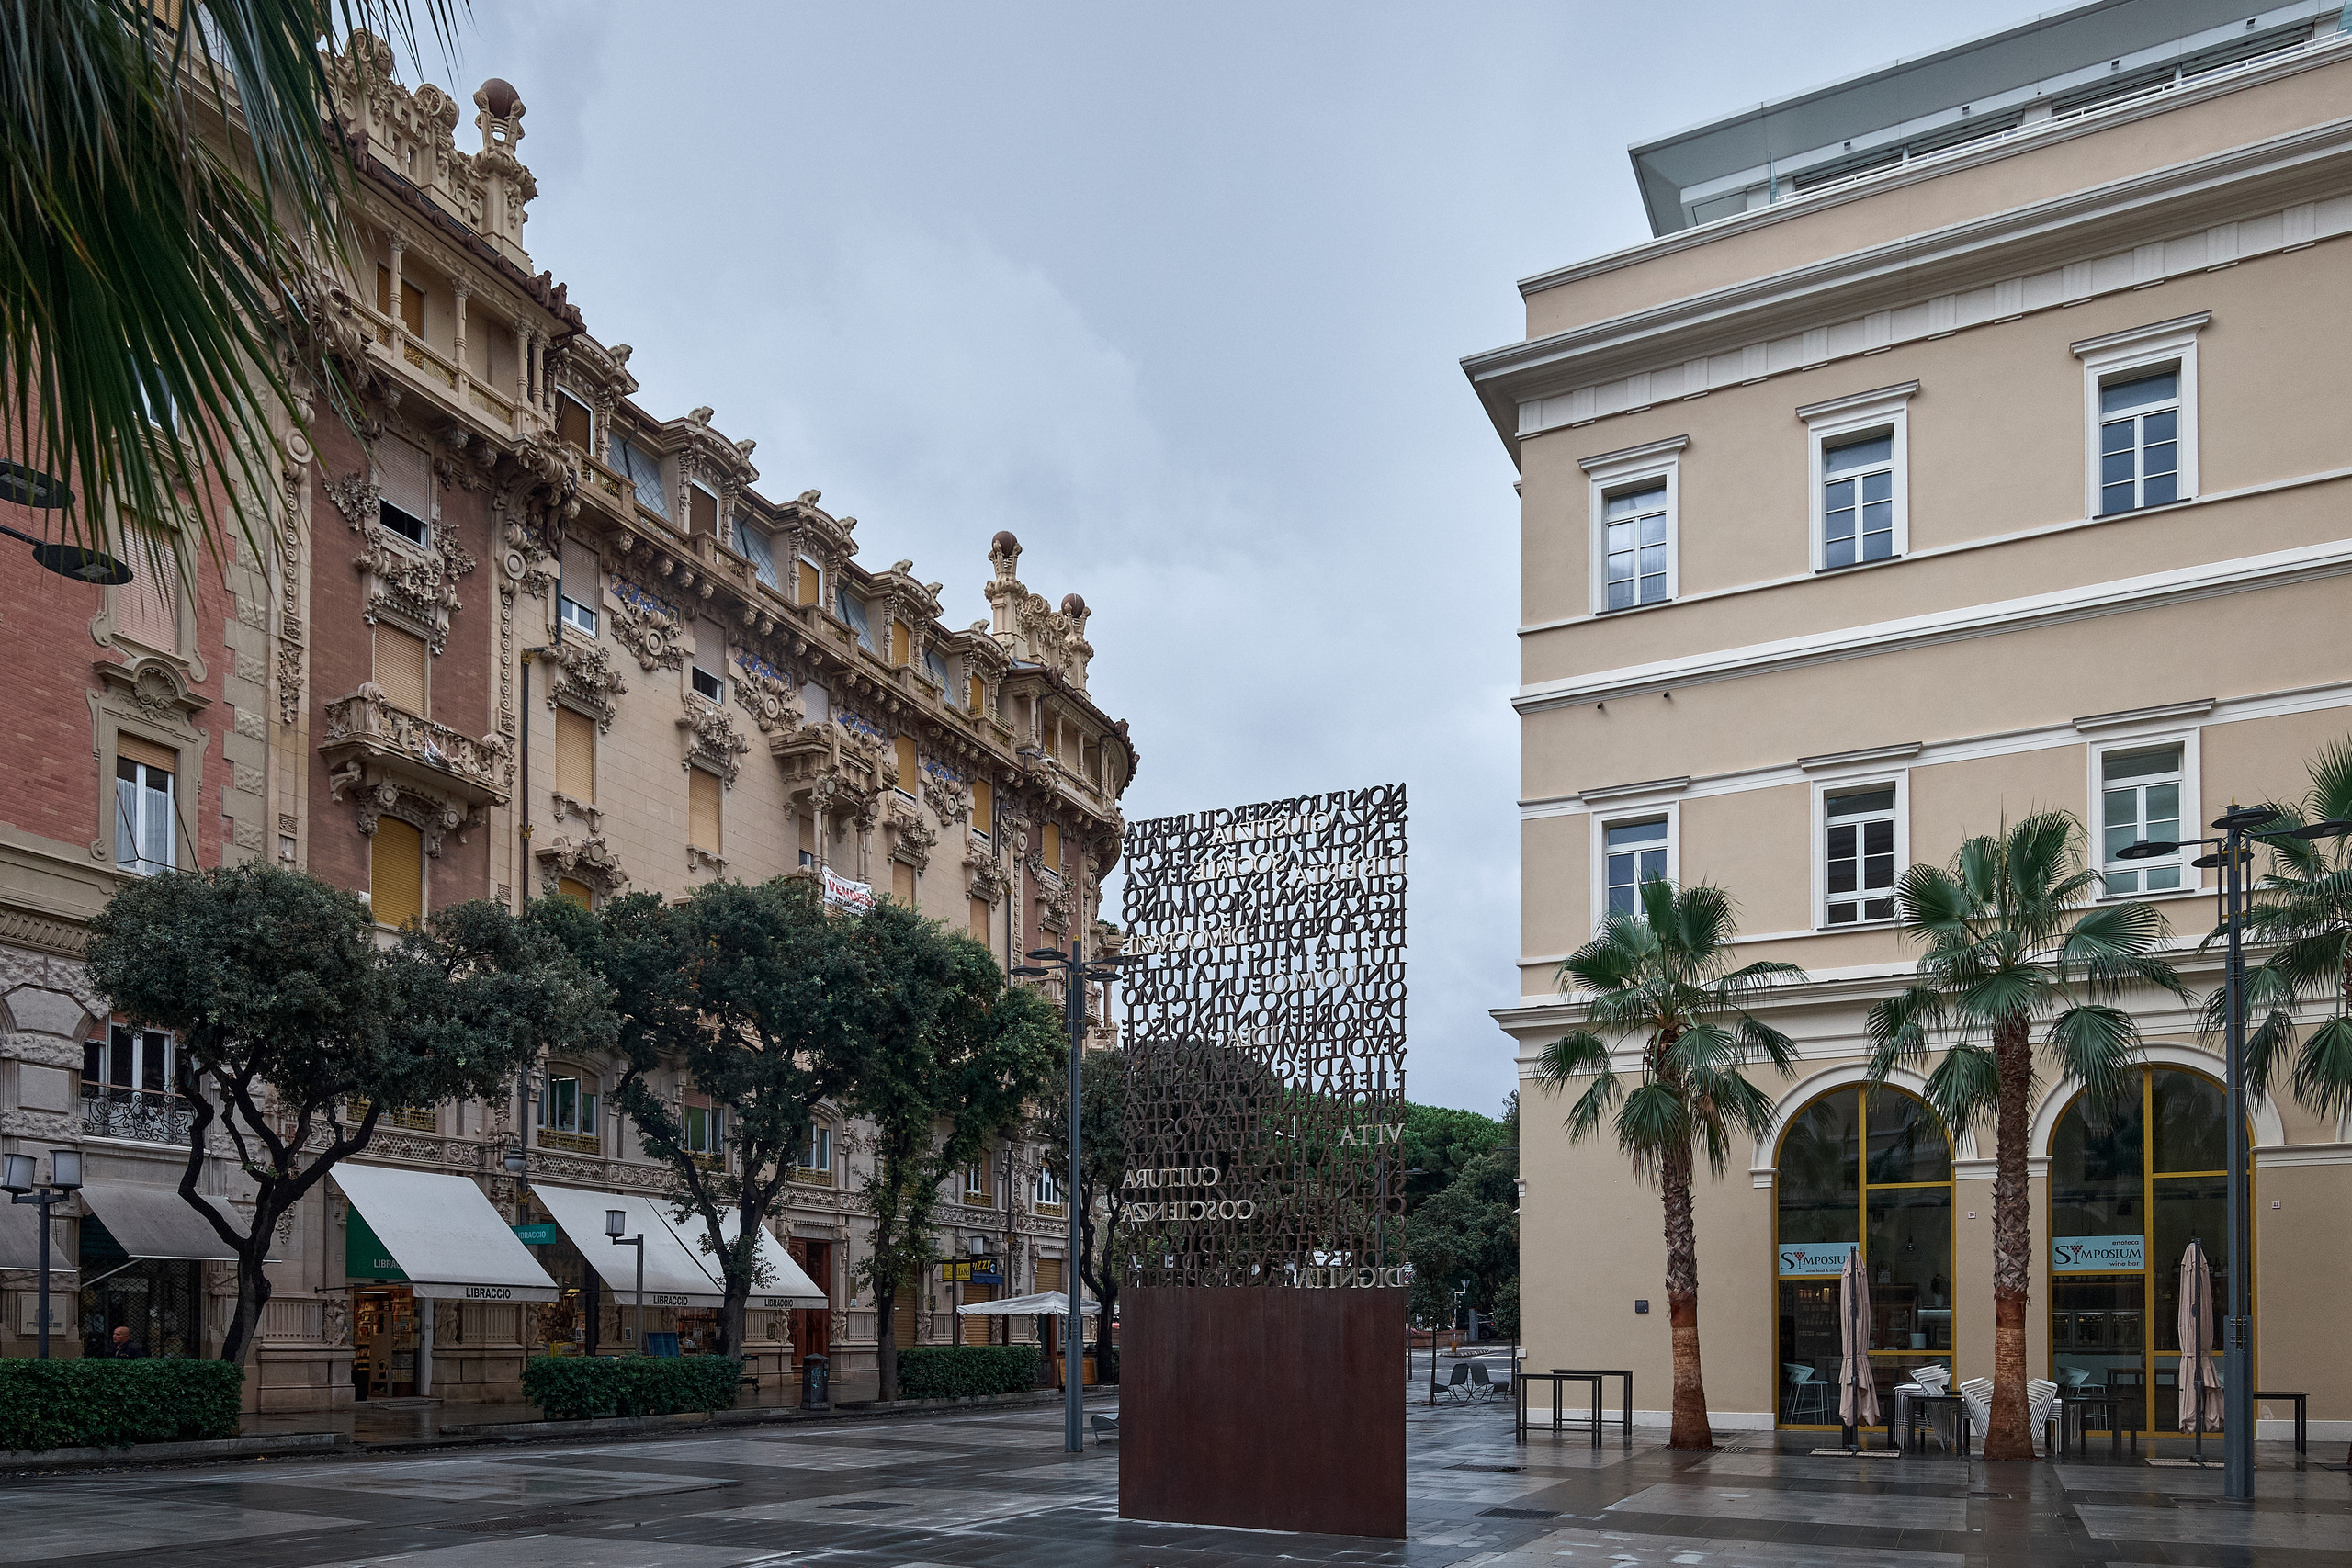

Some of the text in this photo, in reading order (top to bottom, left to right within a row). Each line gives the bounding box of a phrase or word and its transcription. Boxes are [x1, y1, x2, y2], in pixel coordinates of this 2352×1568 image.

[516, 1231, 547, 1239] IBRACCIO
[1781, 1251, 1846, 1270] SYMPOSIU
[2054, 1245, 2142, 1265] SYMPOSIUM
[466, 1287, 511, 1299] LIBRACCIO
[653, 1295, 688, 1306] LIBRACCIO
[764, 1298, 794, 1308] LIBRACCIO
